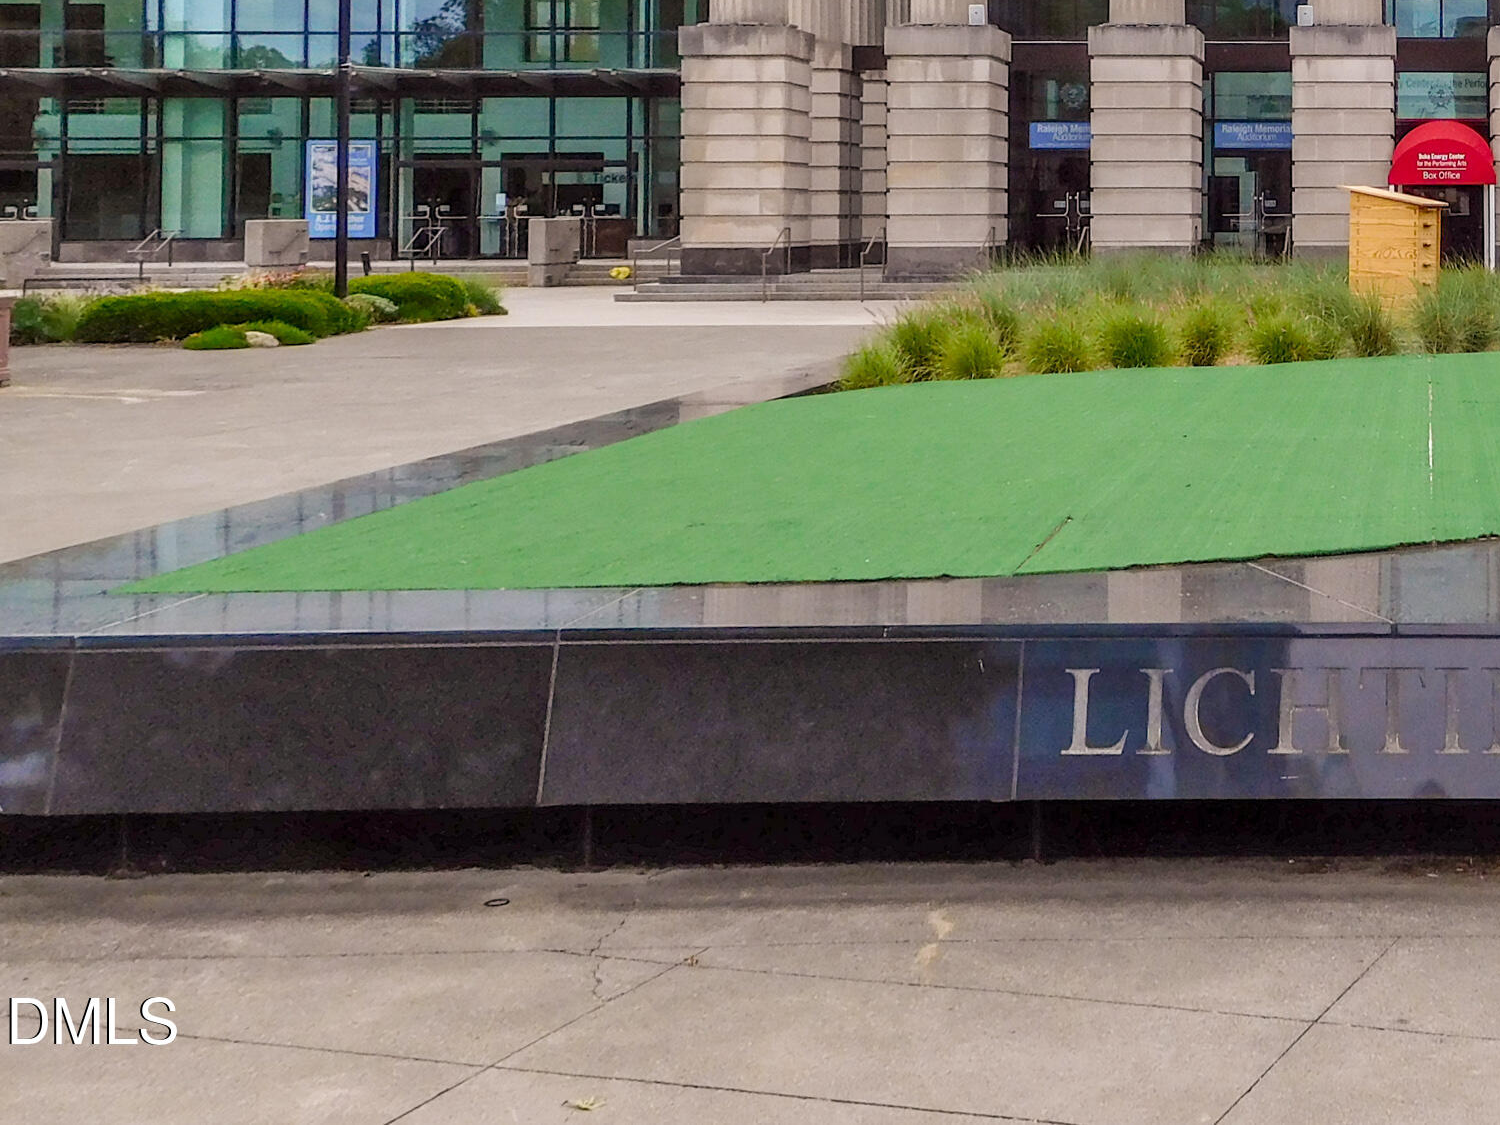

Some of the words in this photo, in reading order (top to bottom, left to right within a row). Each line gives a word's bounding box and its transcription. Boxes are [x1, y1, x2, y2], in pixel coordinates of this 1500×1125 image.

[1222, 123, 1253, 134] Raleigh
[1237, 132, 1277, 141] Auditorium
[1431, 153, 1448, 161] Energy
[1423, 171, 1437, 179] Box
[1438, 171, 1461, 179] Office
